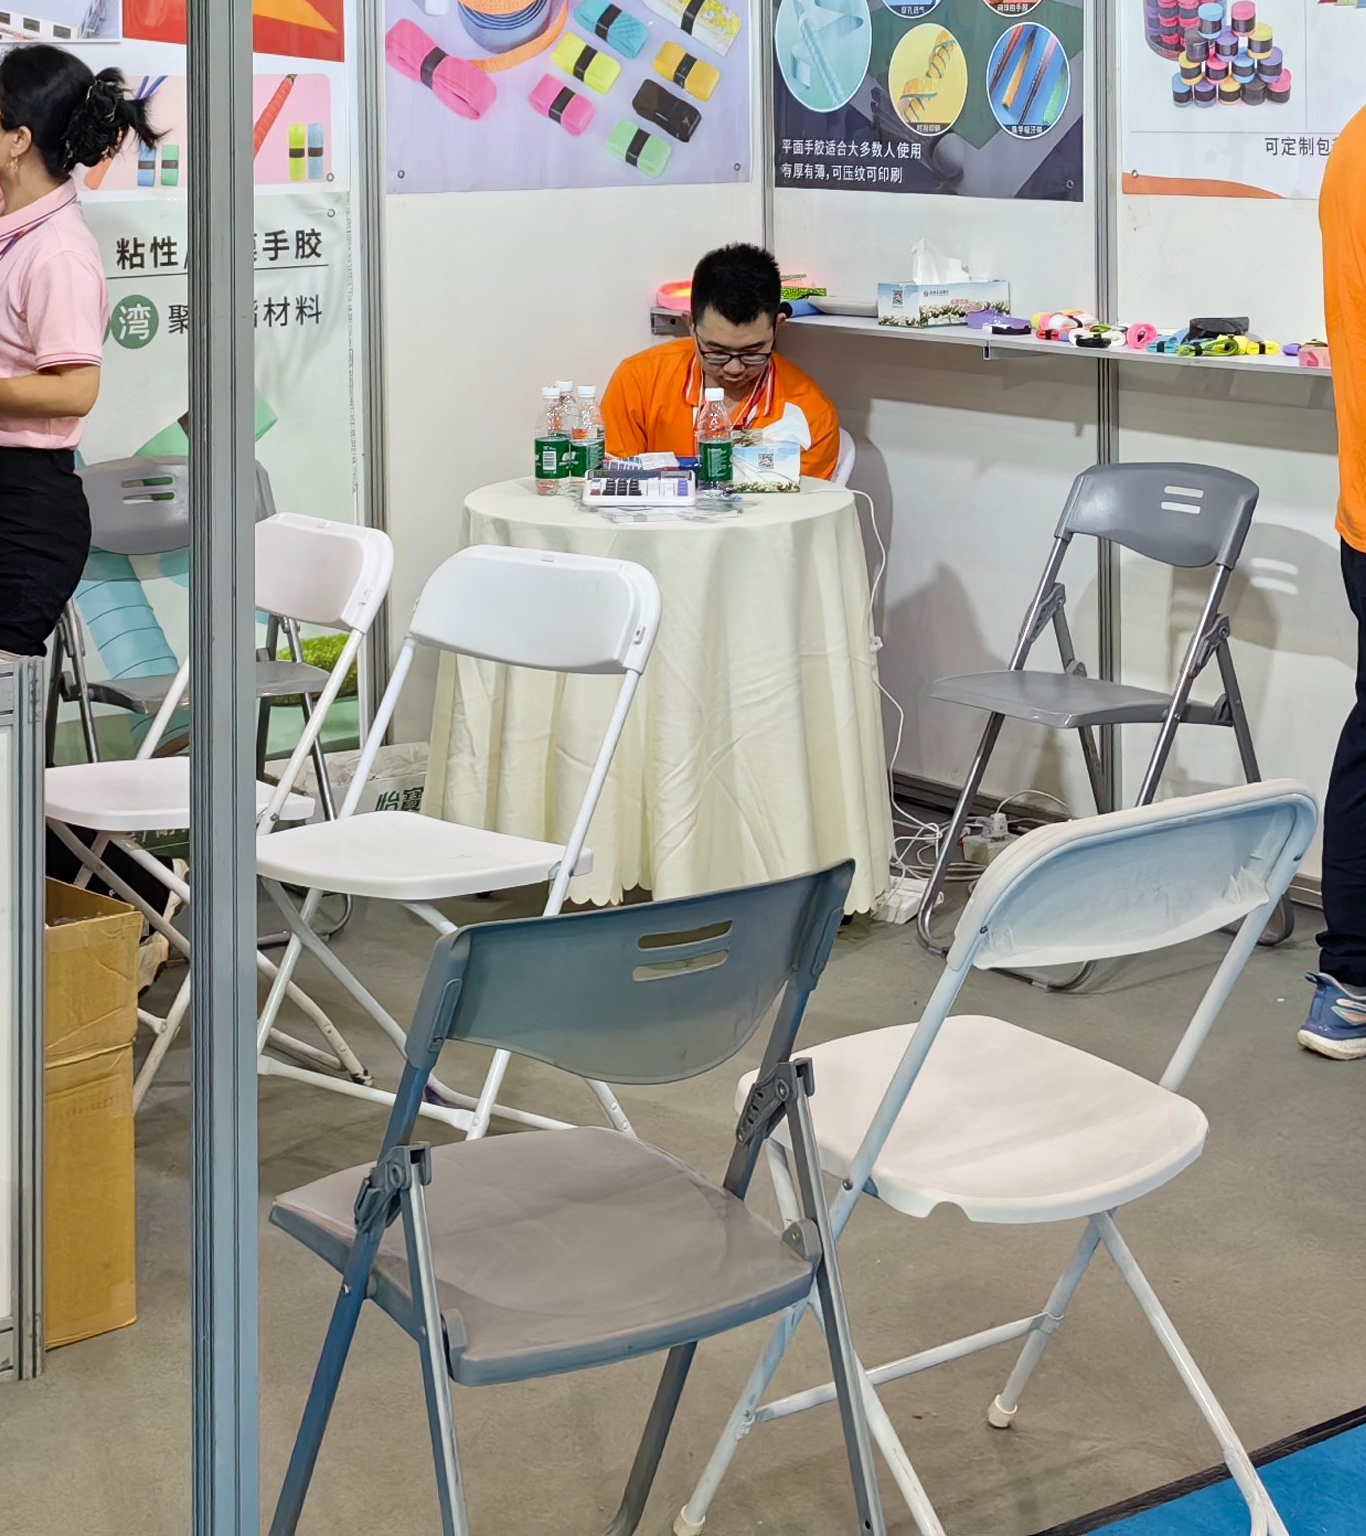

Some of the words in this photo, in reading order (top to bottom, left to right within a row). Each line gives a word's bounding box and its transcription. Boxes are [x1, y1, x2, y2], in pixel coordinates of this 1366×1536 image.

[782, 139, 921, 160] 平面手胶适合大多数人使用
[1265, 136, 1338, 156] 可定制包
[116, 235, 188, 271] 粘性
